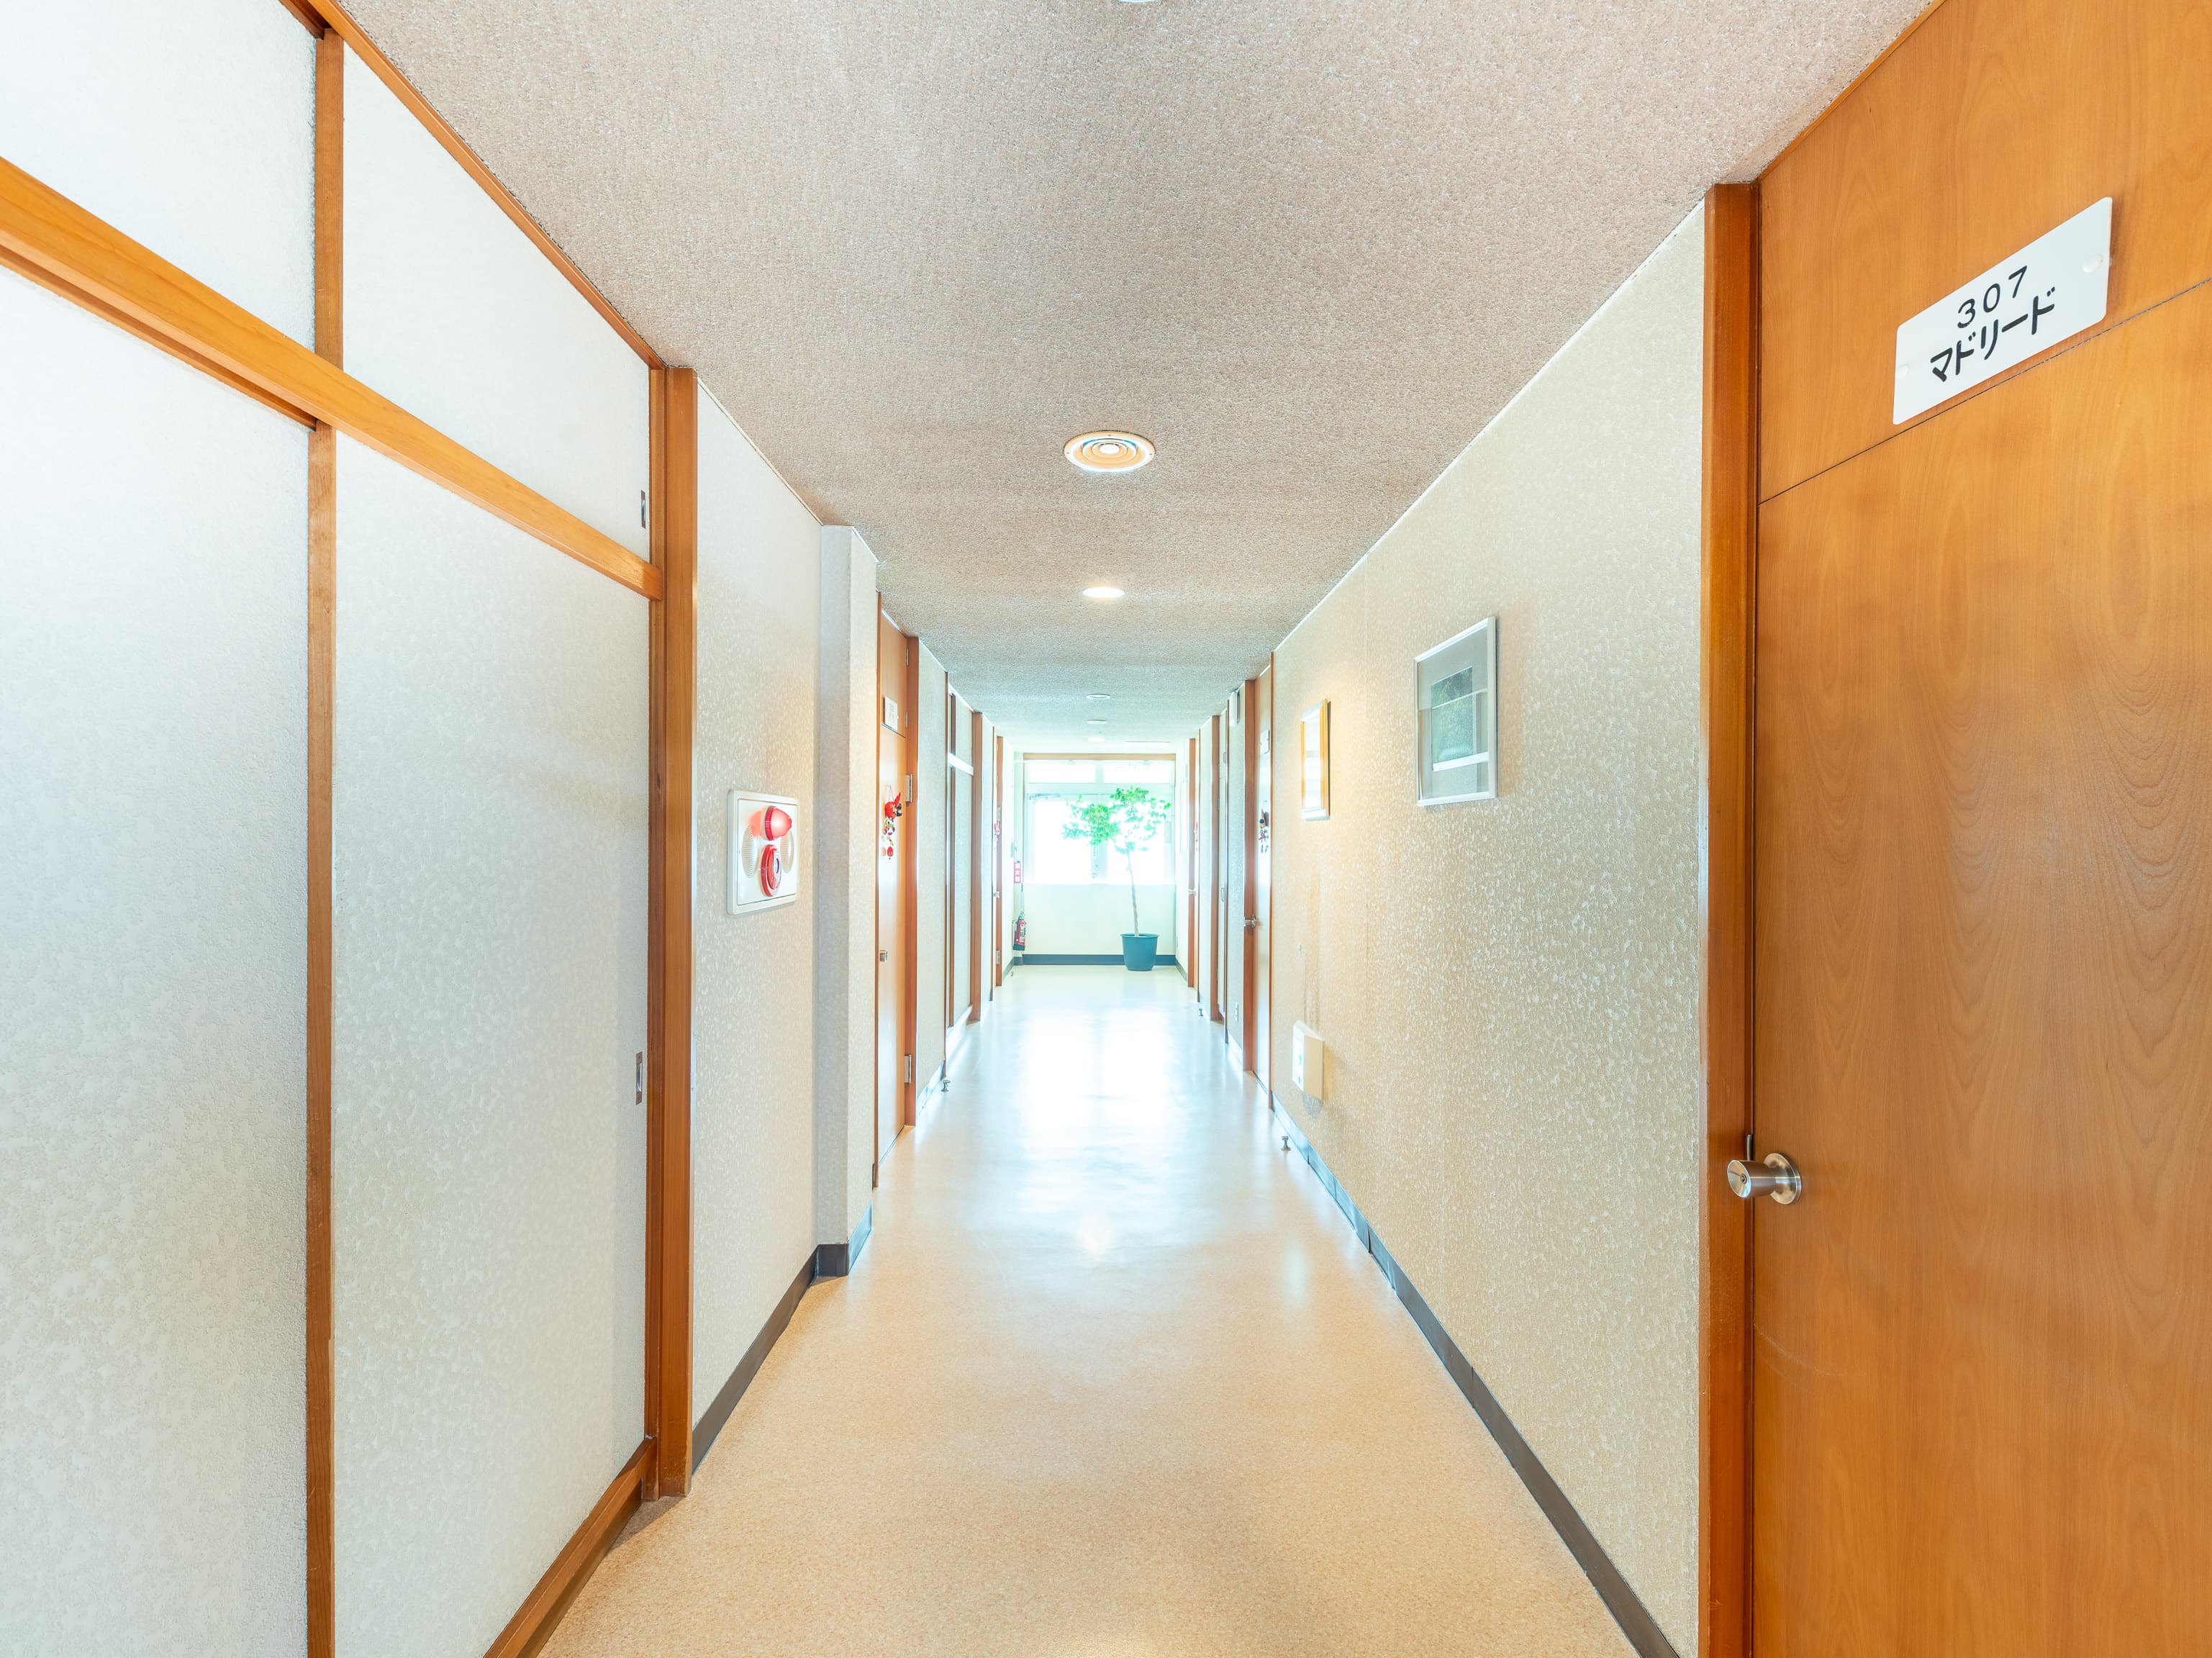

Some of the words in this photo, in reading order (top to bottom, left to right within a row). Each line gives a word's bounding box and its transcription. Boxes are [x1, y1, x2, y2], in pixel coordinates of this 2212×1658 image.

[1930, 286, 2056, 382] マドリード
[1957, 266, 2028, 329] 307
